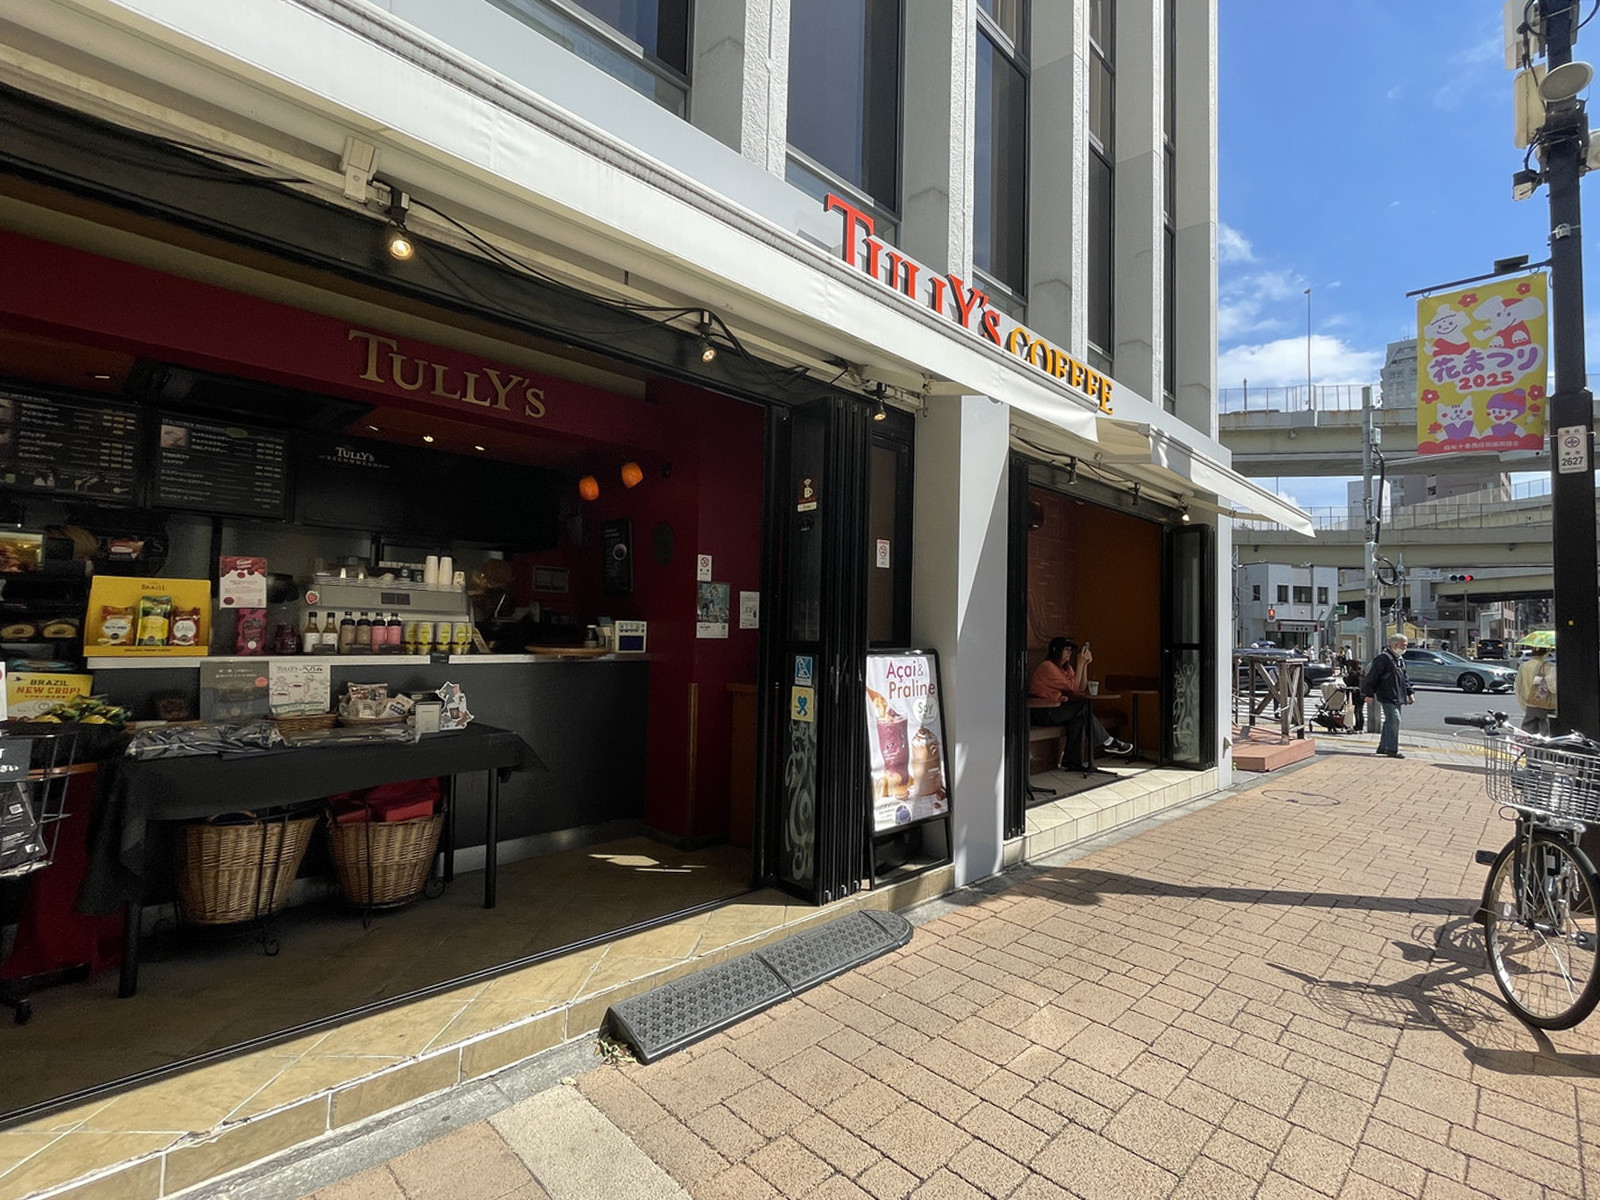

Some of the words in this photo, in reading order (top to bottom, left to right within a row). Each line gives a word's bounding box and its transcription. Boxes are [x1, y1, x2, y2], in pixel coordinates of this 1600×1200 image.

[349, 329, 546, 418] TULLY'S
[1007, 326, 1114, 415] COFFEE
[1429, 346, 1539, 383] 花まつり
[1458, 370, 1515, 391] 2025
[1561, 456, 1584, 467] 2627
[16, 686, 45, 694] NEW
[47, 686, 80, 695] CROP!
[29, 679, 69, 687] BRAZIL
[888, 678, 936, 700] Praline
